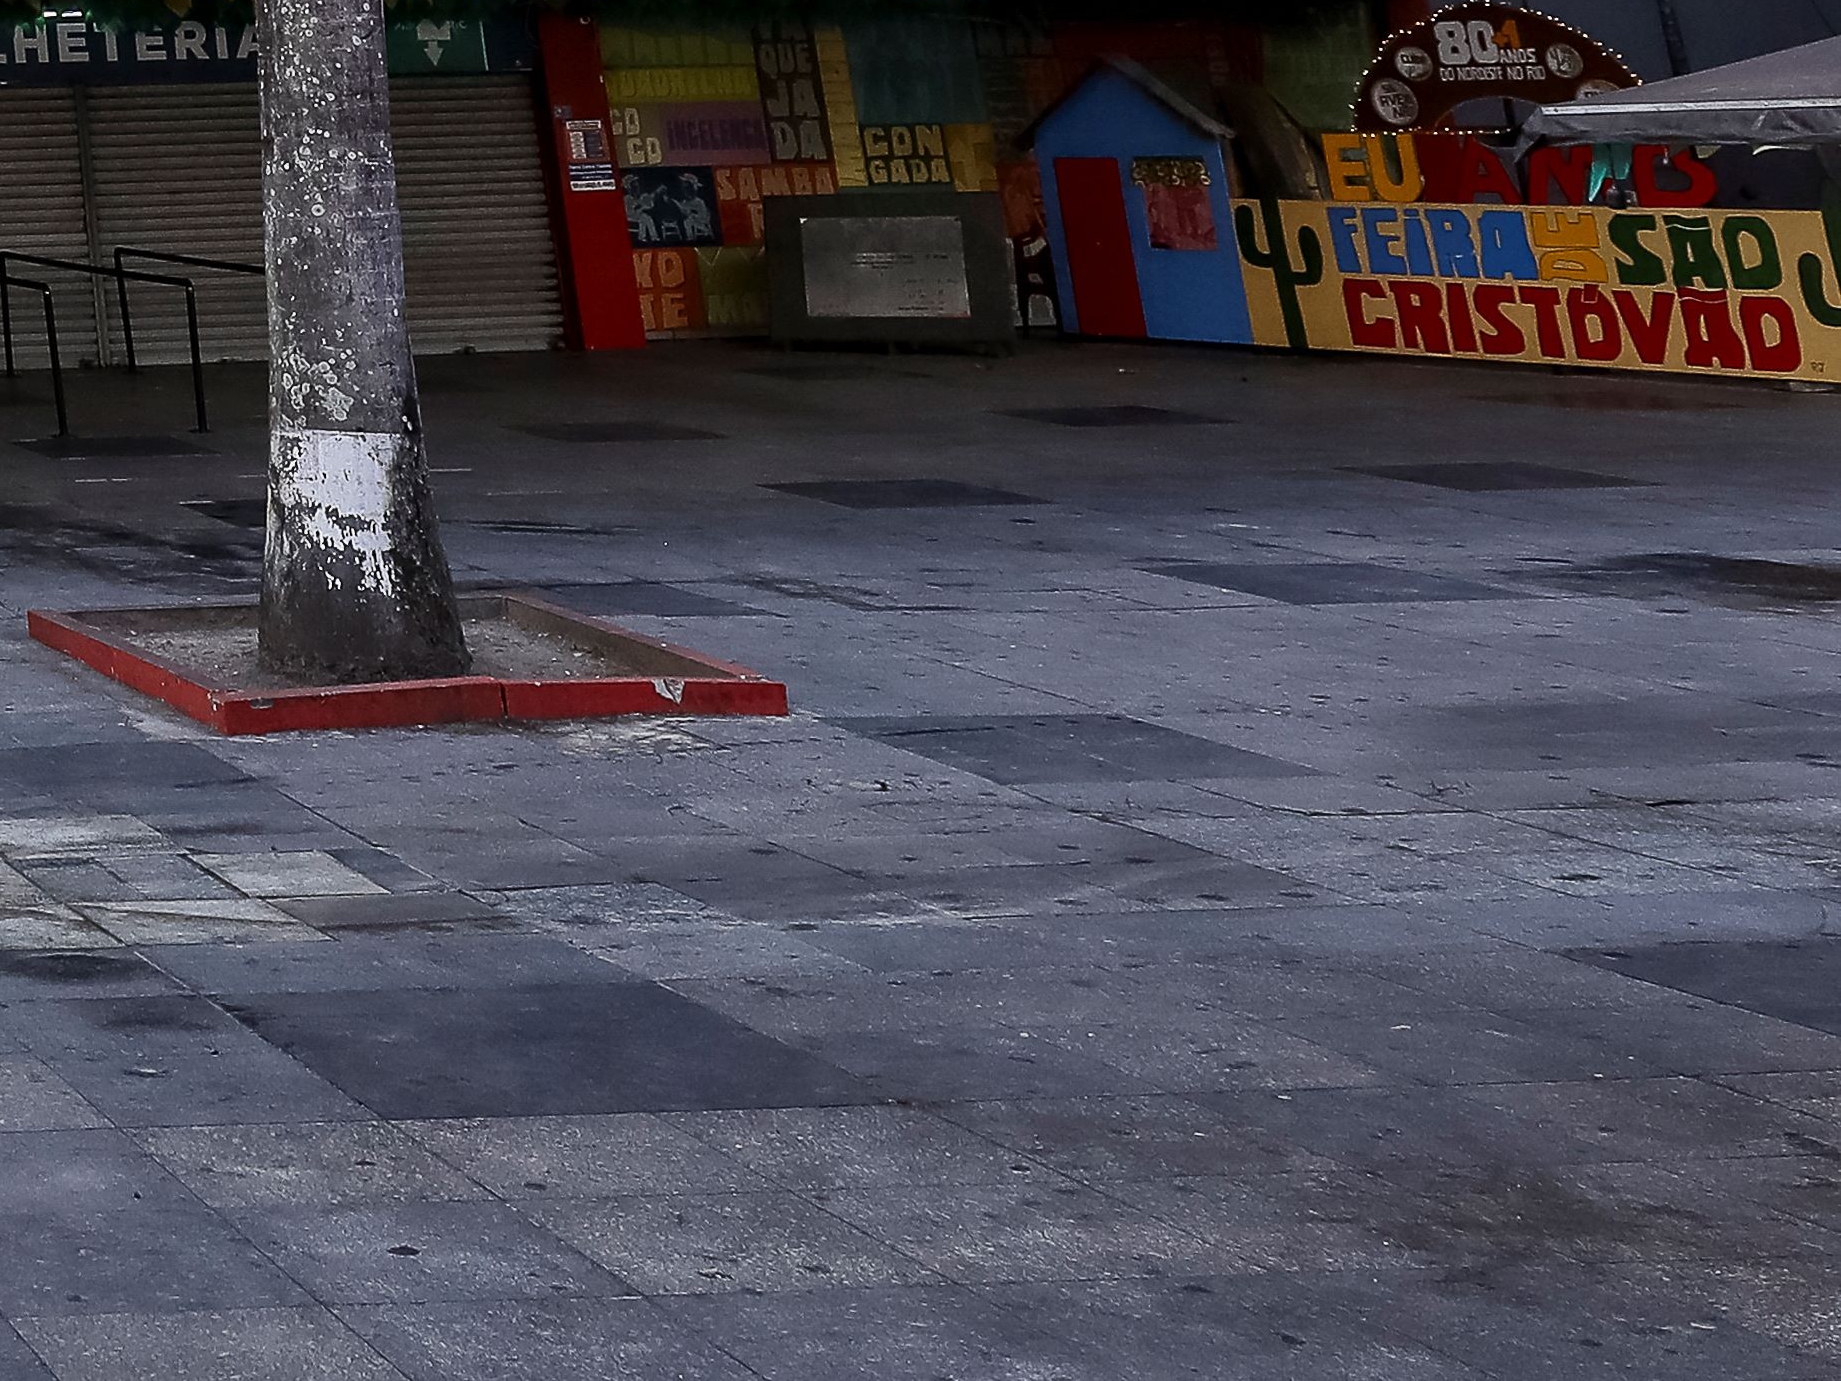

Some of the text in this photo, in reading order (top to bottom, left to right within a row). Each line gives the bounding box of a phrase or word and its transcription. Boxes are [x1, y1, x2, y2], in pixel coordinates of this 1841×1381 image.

[863, 124, 945, 157] CON
[1322, 131, 1424, 202] EU
[716, 166, 836, 201] SAMBA
[869, 158, 952, 184] GADA
[1531, 211, 1609, 283] DE
[1607, 213, 1783, 291] SÃO
[1342, 278, 1803, 374] CRISTÓVÃO
